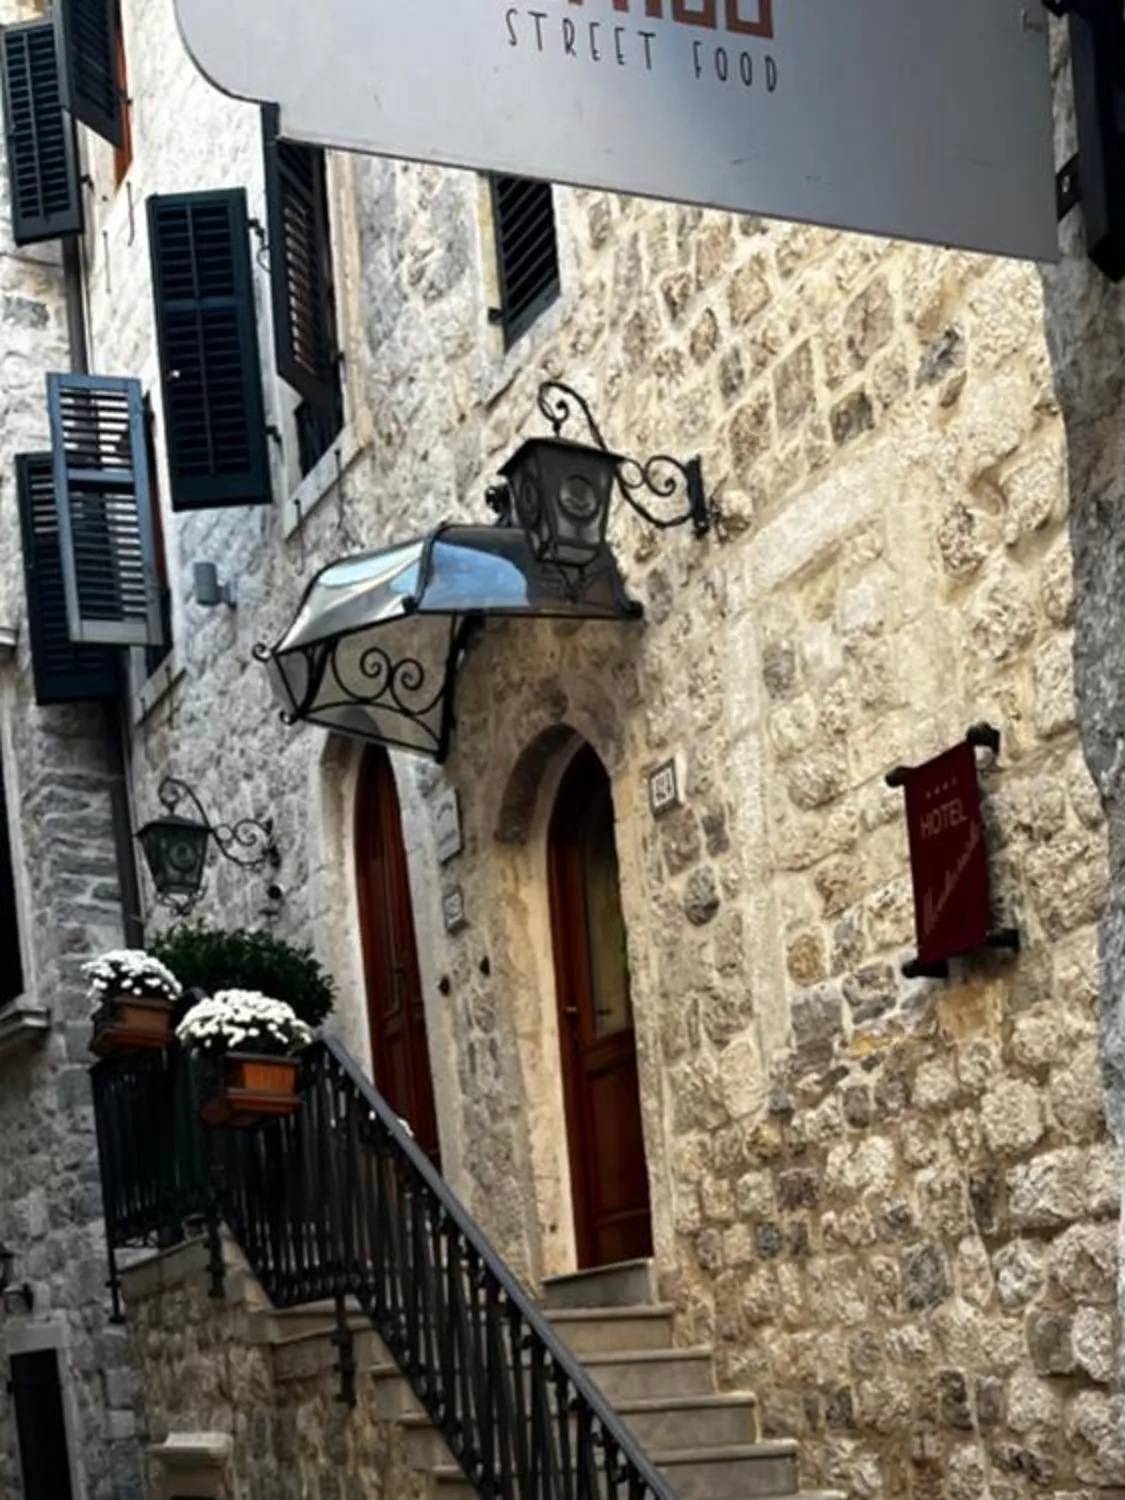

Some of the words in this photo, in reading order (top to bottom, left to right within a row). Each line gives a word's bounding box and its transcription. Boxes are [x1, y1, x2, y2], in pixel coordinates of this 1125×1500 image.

[505, 8, 656, 70] STREET
[693, 40, 777, 93] FOOD
[920, 798, 967, 840] HOTEL
